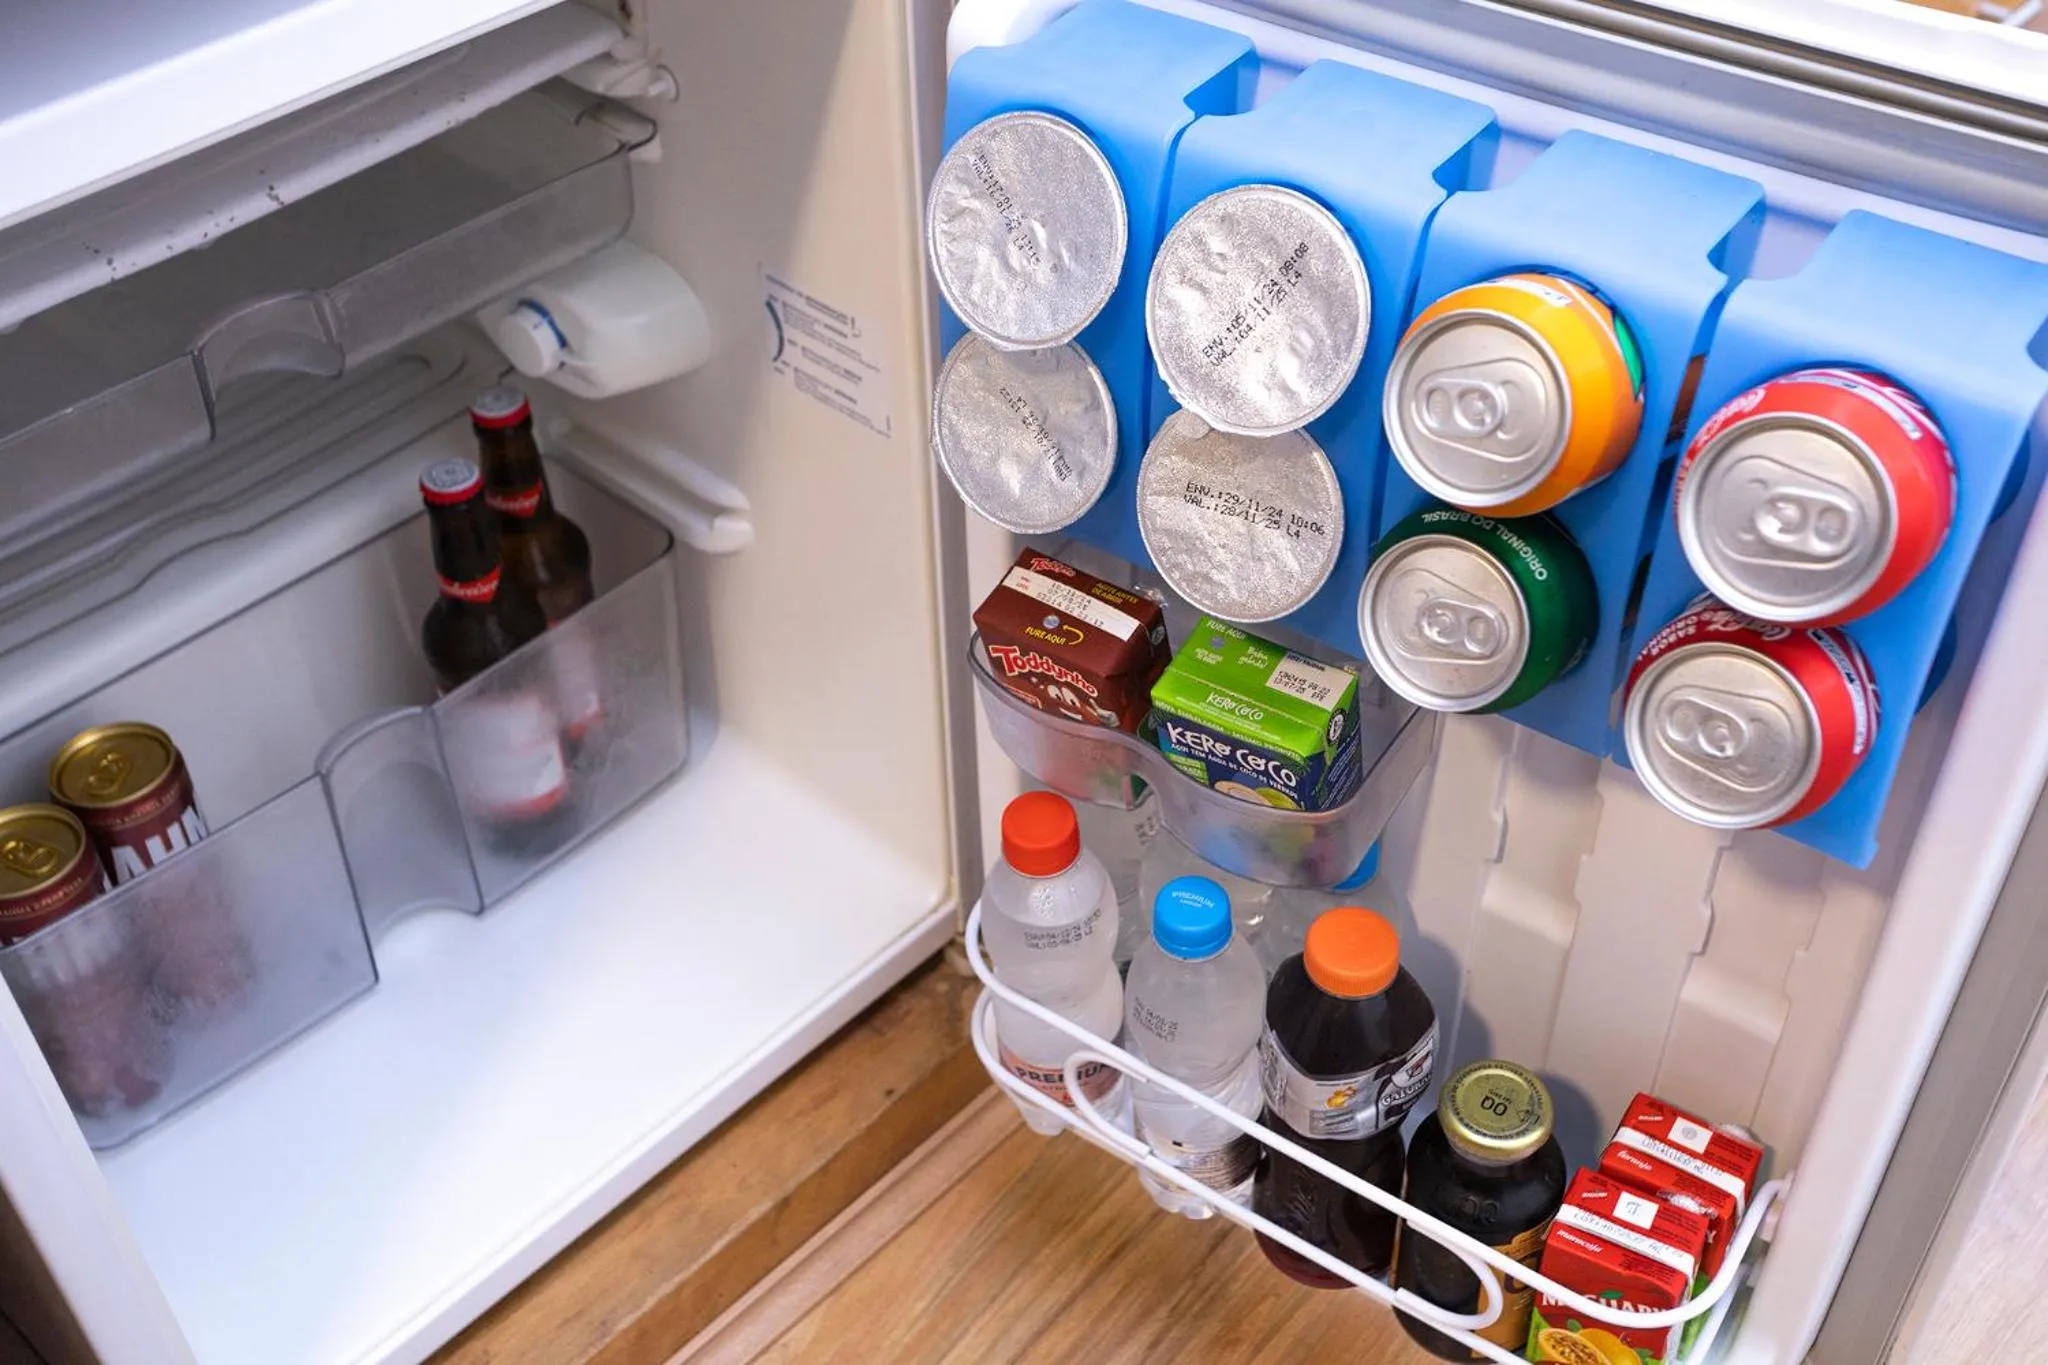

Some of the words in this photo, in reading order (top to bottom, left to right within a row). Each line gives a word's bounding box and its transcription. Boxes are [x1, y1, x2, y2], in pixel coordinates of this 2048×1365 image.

[1421, 509, 1471, 524] BRASIL
[1286, 524, 1301, 540] L4
[1496, 523, 1548, 580] ORIGINAL
[1025, 626, 1047, 639] FURE
[1046, 633, 1066, 646] AQUI
[1650, 624, 1697, 656] SABOR
[988, 645, 1099, 698] Toddynho
